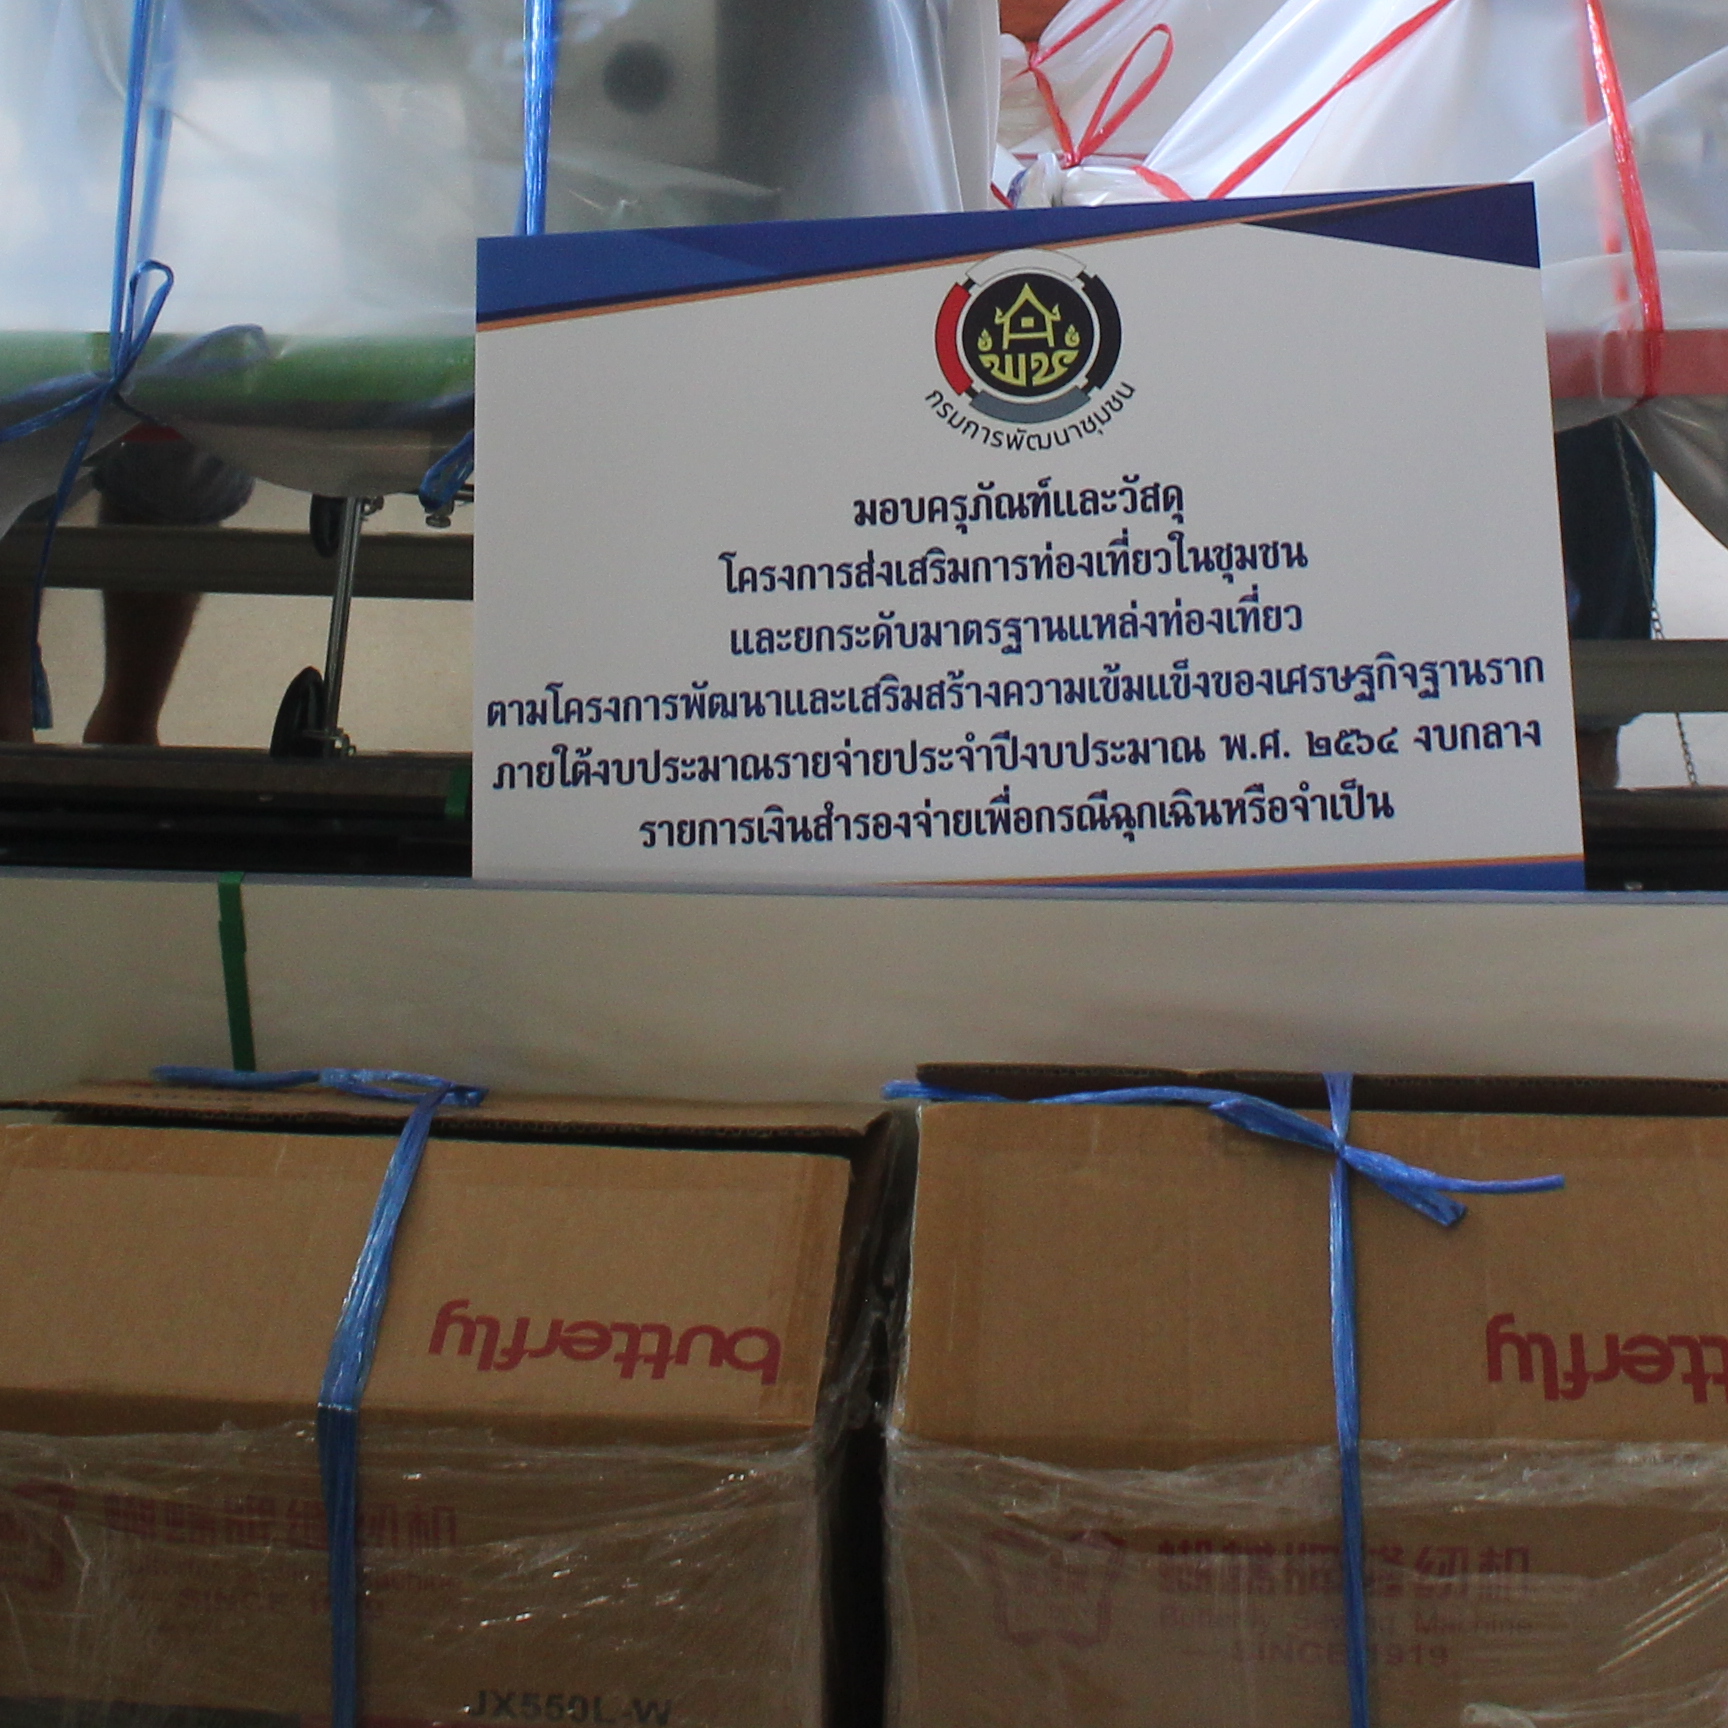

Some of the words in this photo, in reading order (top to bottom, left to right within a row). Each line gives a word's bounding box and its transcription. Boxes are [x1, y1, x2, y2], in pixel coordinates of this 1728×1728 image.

[924, 381, 1136, 451] กรมการพัฒนาชุมชน
[852, 473, 1185, 536] มอบครุภัณฑ์และวัสดุ
[718, 527, 1309, 594] โครงการส่งเสริมการท่องเที่ยวในชุมชน
[729, 583, 1304, 657] และยกระดับมาตรฐานแหล่งท่องเที่ยว
[486, 650, 1545, 729] ตามโครงการพัฒนาและเสริมสร้างความเข้มแข็งของเศรษฐกิจฐานราก
[491, 729, 1206, 791] ภายใต้งบประมาณรายจ่ายประจำปีงบประมาณ
[1219, 727, 1292, 762] พ.ศ.
[1305, 725, 1400, 758] ๒๕๖๔
[1413, 717, 1543, 755] งบกลาง
[638, 778, 1396, 849] รายการเงินสำรองจ่ายเพื่อกรณีฉุกเฉินหรือจำเป็น
[428, 1298, 784, 1386] butterfly
